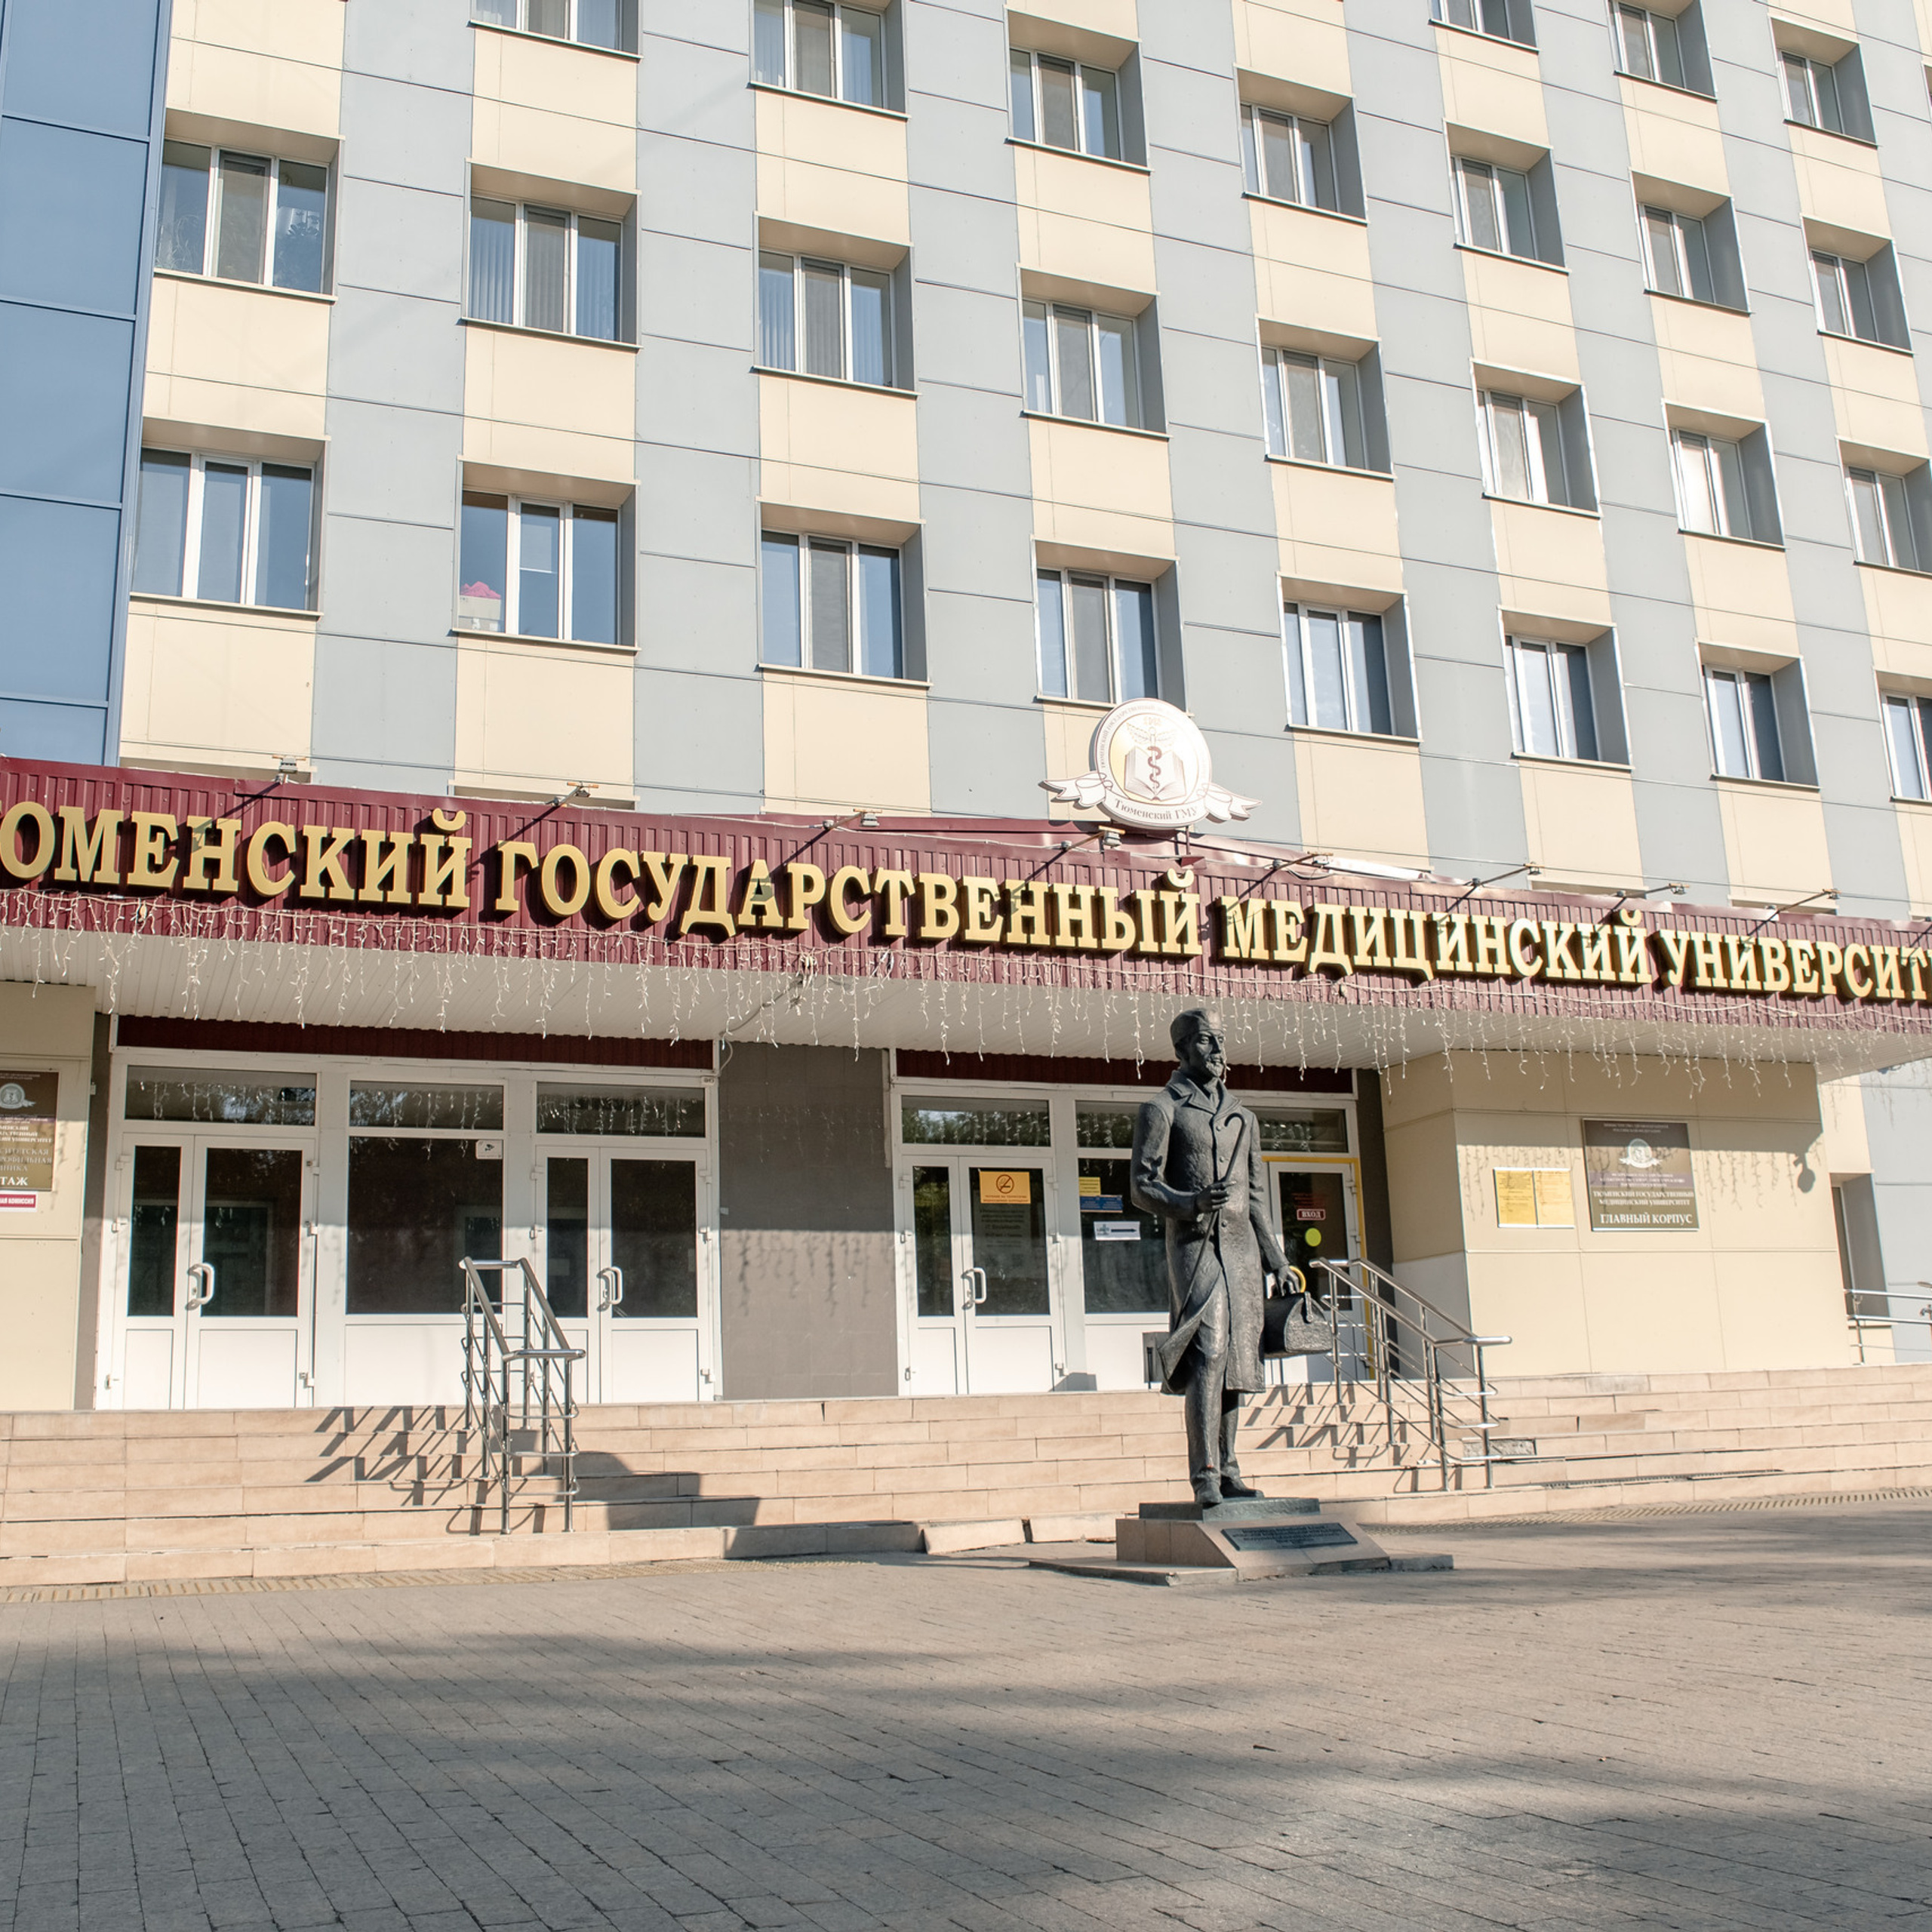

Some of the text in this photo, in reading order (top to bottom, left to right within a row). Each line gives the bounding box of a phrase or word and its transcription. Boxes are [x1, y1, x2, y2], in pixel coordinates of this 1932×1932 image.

[1115, 798, 1198, 820] Тюменский ГМУ
[495, 840, 1204, 956] ГОСУДАРСТВЕННЫЙ
[1220, 896, 1653, 984] МЕДИЦИНСКИЙ
[1659, 929, 1932, 1001] УНИВЕРСИТ
[0, 1177, 29, 1186] ТАЖ
[1301, 1211, 1321, 1219] ВХОД
[1600, 1212, 1693, 1226] ГЛАВНЫЙ КОРПУС
